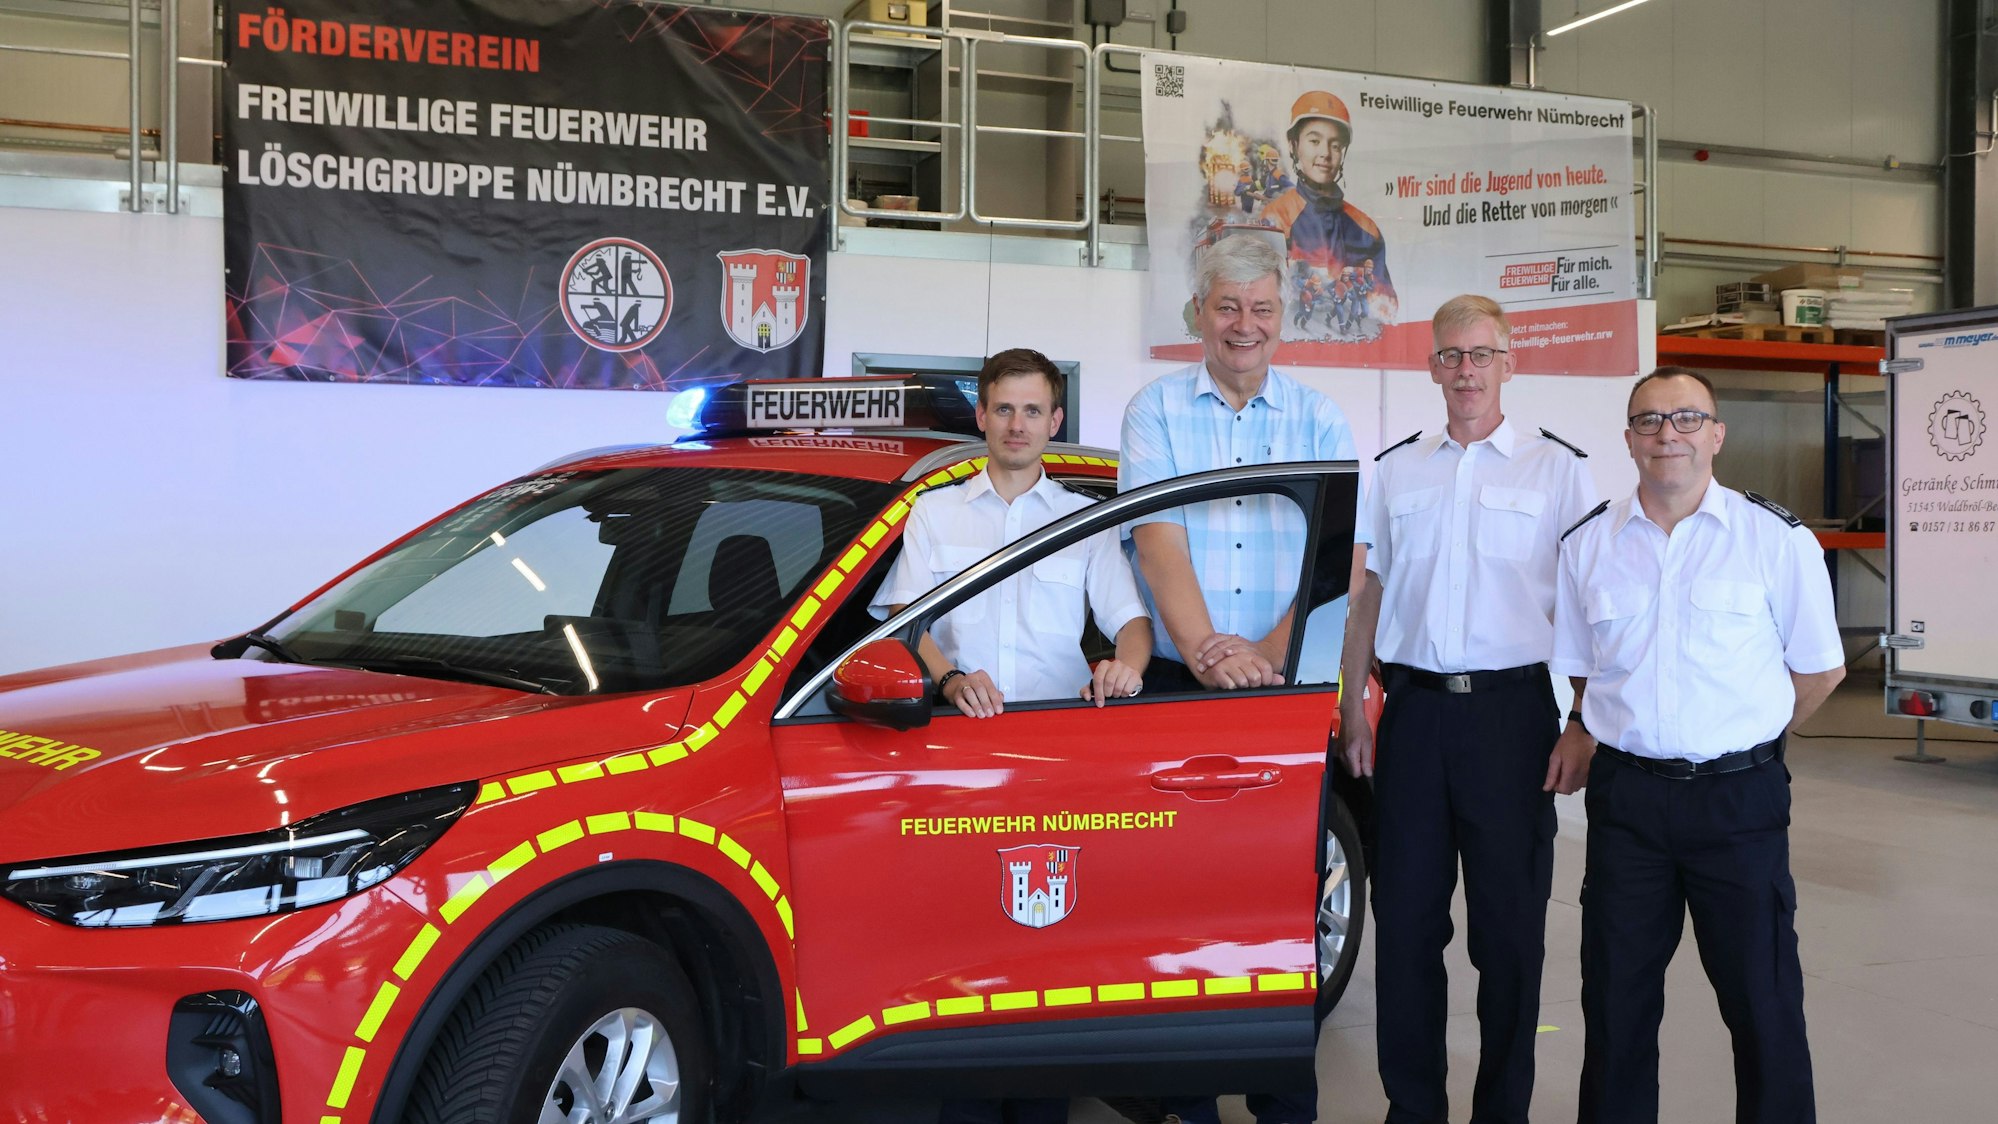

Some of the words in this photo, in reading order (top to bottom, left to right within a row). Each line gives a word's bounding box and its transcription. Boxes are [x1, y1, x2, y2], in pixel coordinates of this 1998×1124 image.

[238, 7, 540, 73] FÖRDERVEREIN
[238, 83, 478, 136] FREIWILLIGE
[491, 103, 708, 151] FEUERWEHR
[1360, 92, 1443, 118] Freiwillige
[1449, 100, 1532, 122] Feuerwehr
[1538, 108, 1624, 128] Nümbrecht
[238, 142, 514, 200] LÖSCHGRUPPE
[527, 162, 746, 213] NÜMBRECHT
[757, 183, 814, 218] E.V.
[1426, 173, 1456, 196] sind
[1461, 172, 1482, 193] die
[1486, 168, 1532, 195] Jugend
[1537, 171, 1561, 188] von
[1566, 164, 1607, 186] heute.
[1423, 204, 1450, 226] Und
[1456, 202, 1477, 224] die
[1482, 200, 1526, 222] Retter
[1532, 201, 1556, 218] von
[1506, 263, 1555, 276] FREIWILLIGE
[1557, 257, 1575, 274] Für
[1578, 256, 1612, 272] mich.
[1501, 275, 1549, 287] FEUERWEHR
[1551, 275, 1570, 292] Für
[1573, 275, 1599, 290] alle.
[1510, 325, 1527, 335] Jetzt
[1528, 322, 1568, 333] mitmachen:
[1510, 330, 1613, 349] freiwillige-feuerwehr.nrw
[751, 389, 900, 420] FEUERWEHR
[1902, 474, 1958, 497] Getränke
[1907, 502, 1935, 513] 51545
[1937, 499, 1998, 512] Waldbröl-Be
[1922, 521, 1945, 532] 0157
[1953, 521, 1965, 532] 31
[1968, 521, 1980, 533] 86
[1983, 521, 1996, 532] 87
[901, 815, 1036, 836] FEUERWEHR
[1043, 811, 1178, 832] NÜMBRECHT
